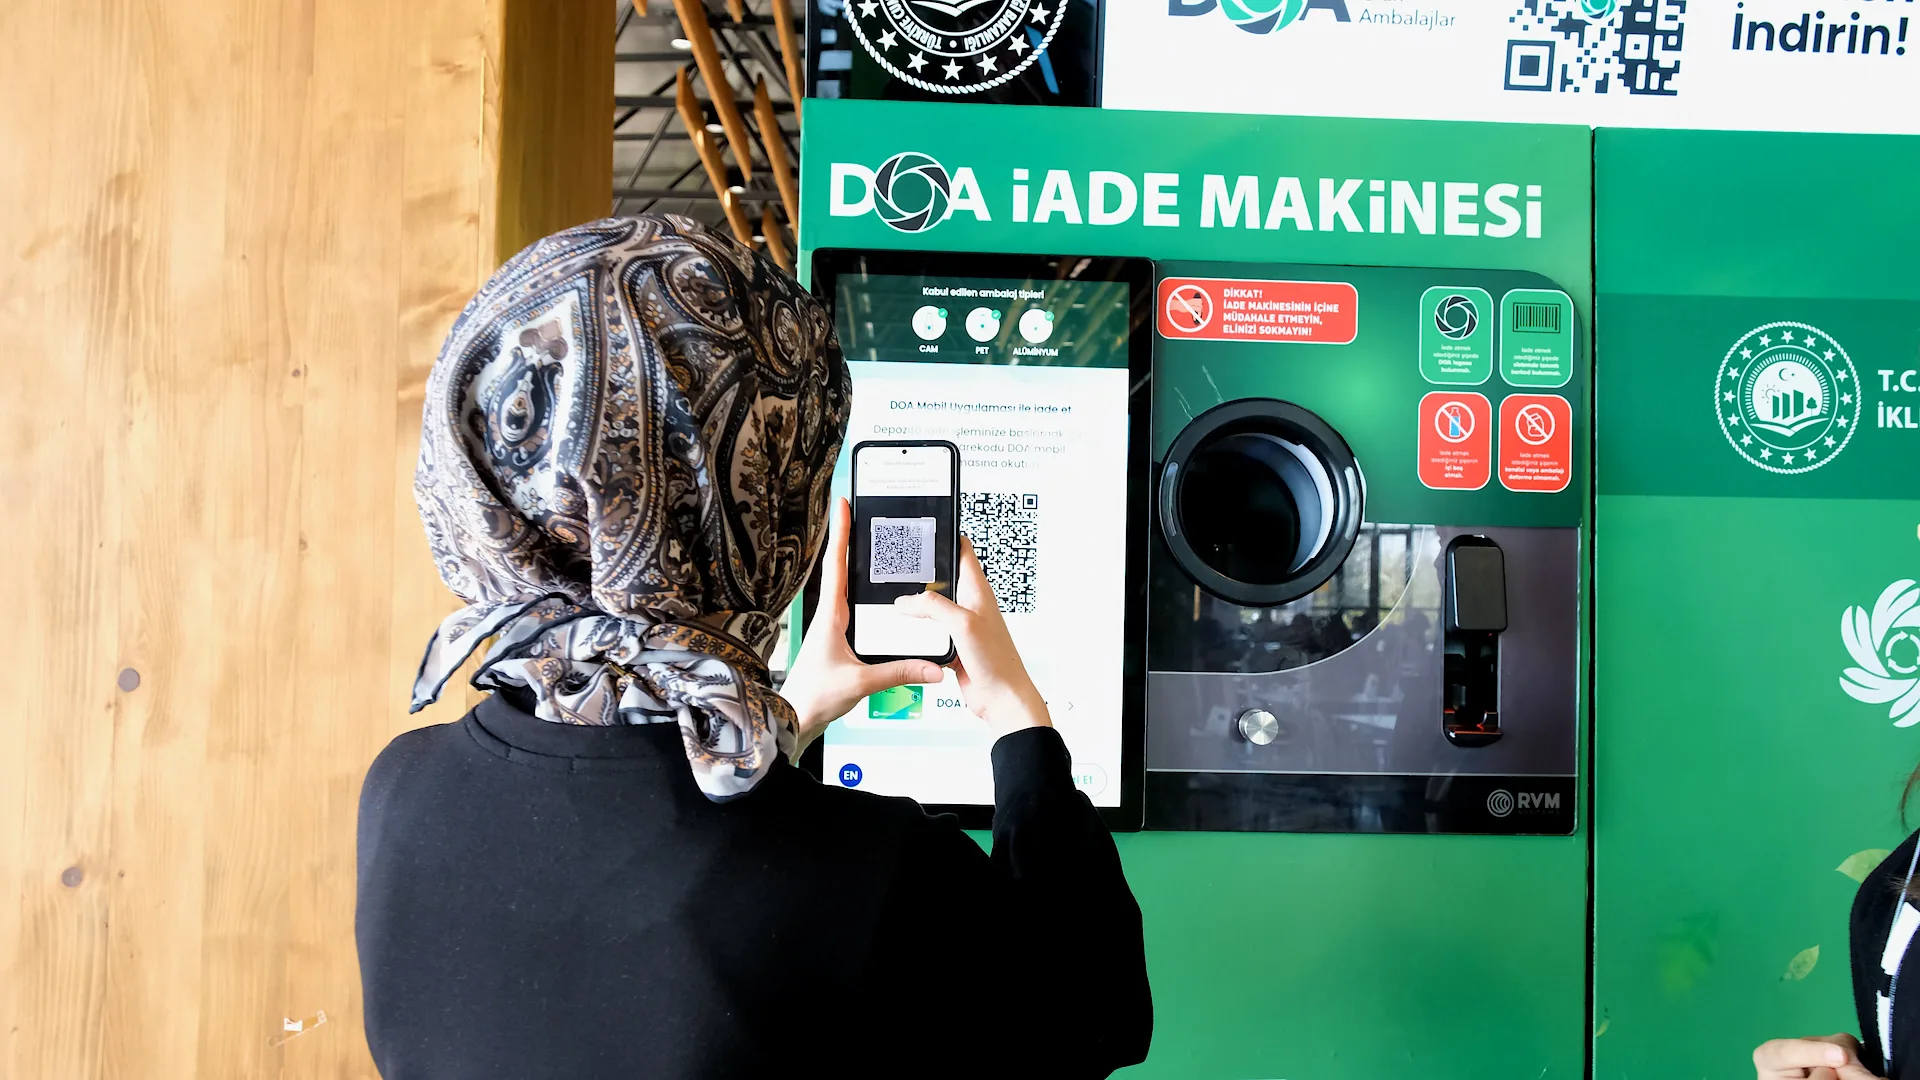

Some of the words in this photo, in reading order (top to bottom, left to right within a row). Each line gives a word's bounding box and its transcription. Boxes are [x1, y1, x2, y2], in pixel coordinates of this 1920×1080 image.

[1359, 8, 1456, 31] Ambalajlar
[899, 15, 942, 50] TÜRKİYE
[1732, 2, 1909, 56] İndirin!
[922, 286, 949, 297] Kabul
[950, 287, 978, 298] edilen
[979, 288, 1018, 300] ambalaj
[1018, 289, 1045, 300] tipleri
[1223, 287, 1263, 298] DİKKAT!
[1223, 299, 1246, 310] İADE
[1248, 300, 1312, 312] MAKİNESİNİN
[1313, 301, 1339, 314] İÇİNE
[1223, 311, 1276, 323] MÜDAHALE
[1277, 313, 1323, 325] ETMEYİN,
[1223, 323, 1257, 334] ELİNİZİ
[1258, 325, 1312, 336] SOKMAYIN!
[918, 344, 939, 353] CAM
[975, 346, 990, 355] PET
[890, 400, 914, 410] DOA
[917, 401, 947, 411] Mobil
[949, 402, 1016, 415] Uygulaması
[1018, 404, 1031, 412] ile
[1034, 404, 1058, 413] iade
[1061, 406, 1072, 414] et
[1878, 400, 1920, 429] İKL
[959, 443, 1005, 453] arekodu
[937, 698, 961, 708] DOA
[843, 768, 858, 780] EN
[1083, 775, 1094, 785] Et
[1517, 792, 1561, 809] RVM
